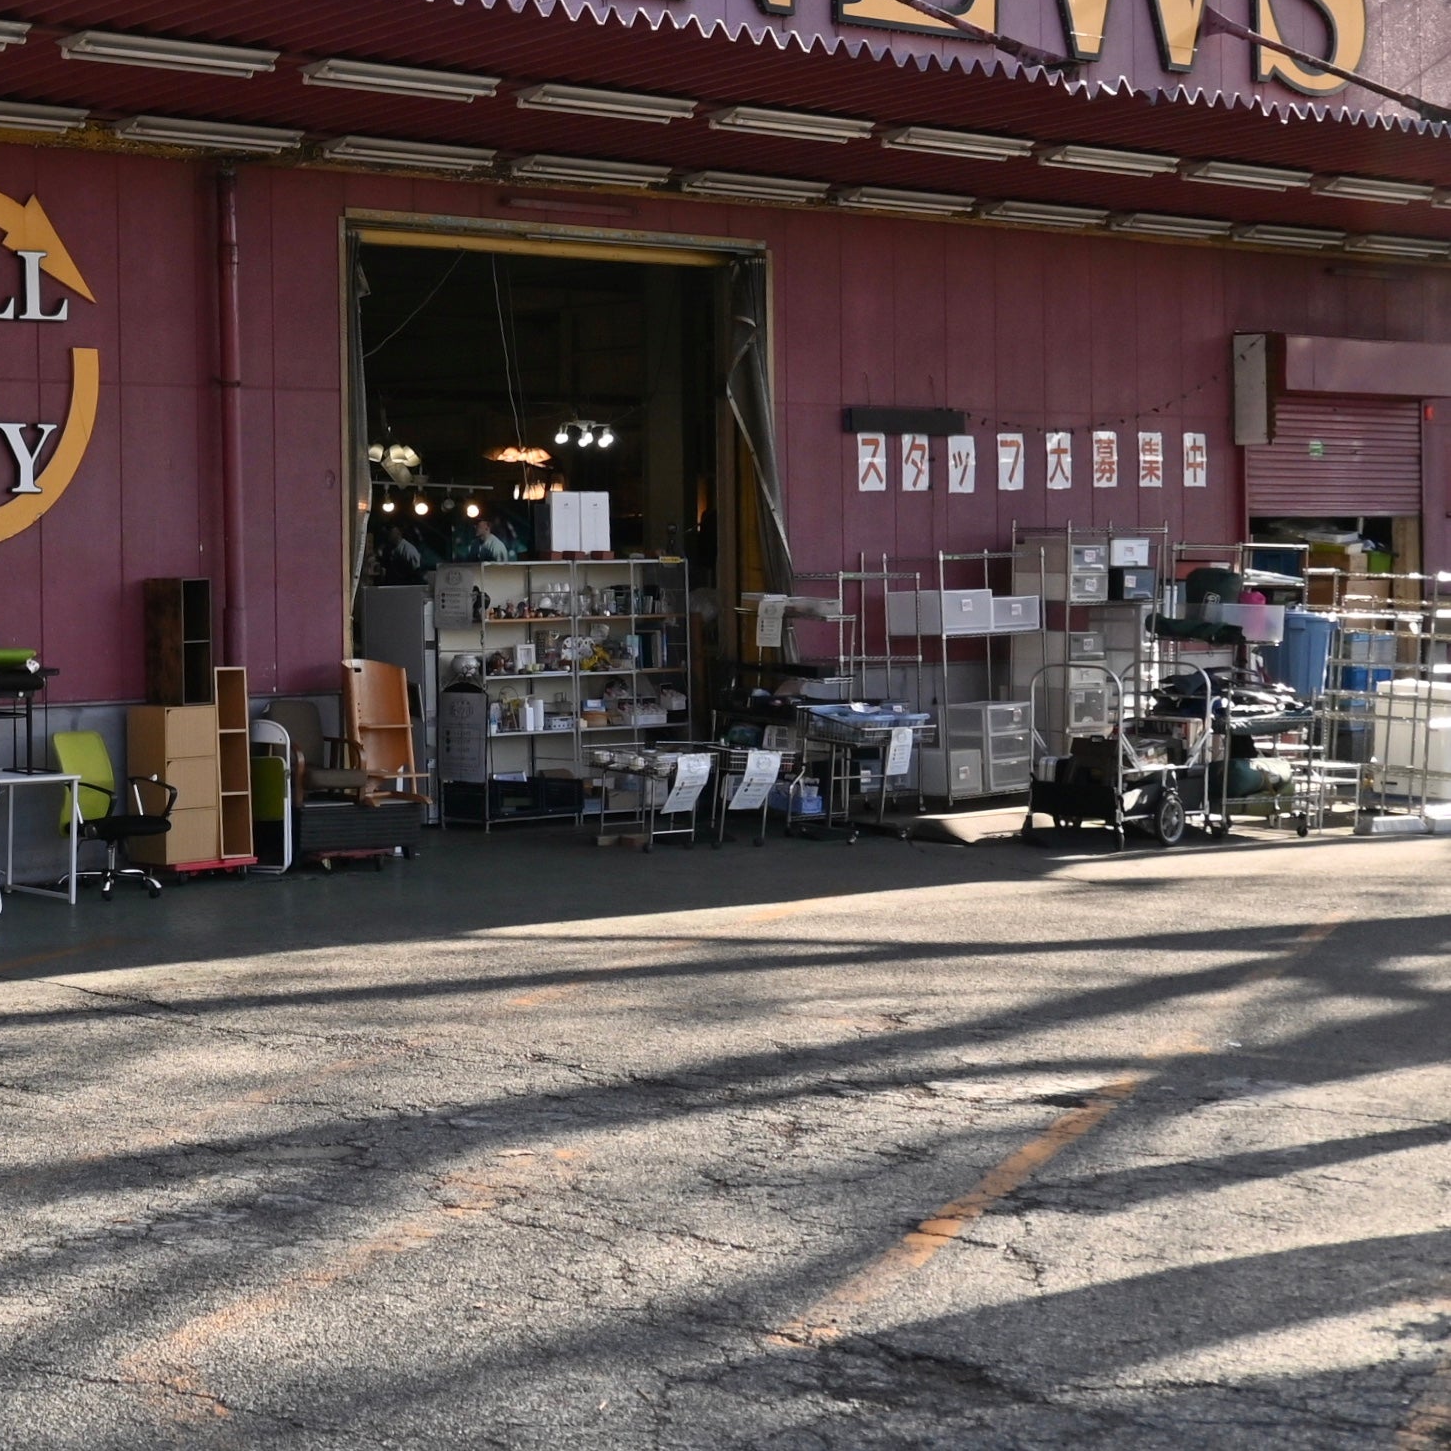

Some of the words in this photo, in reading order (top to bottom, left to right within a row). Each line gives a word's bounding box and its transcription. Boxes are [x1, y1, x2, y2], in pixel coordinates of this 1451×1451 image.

[859, 437, 1206, 488] スタッフ大募集中
